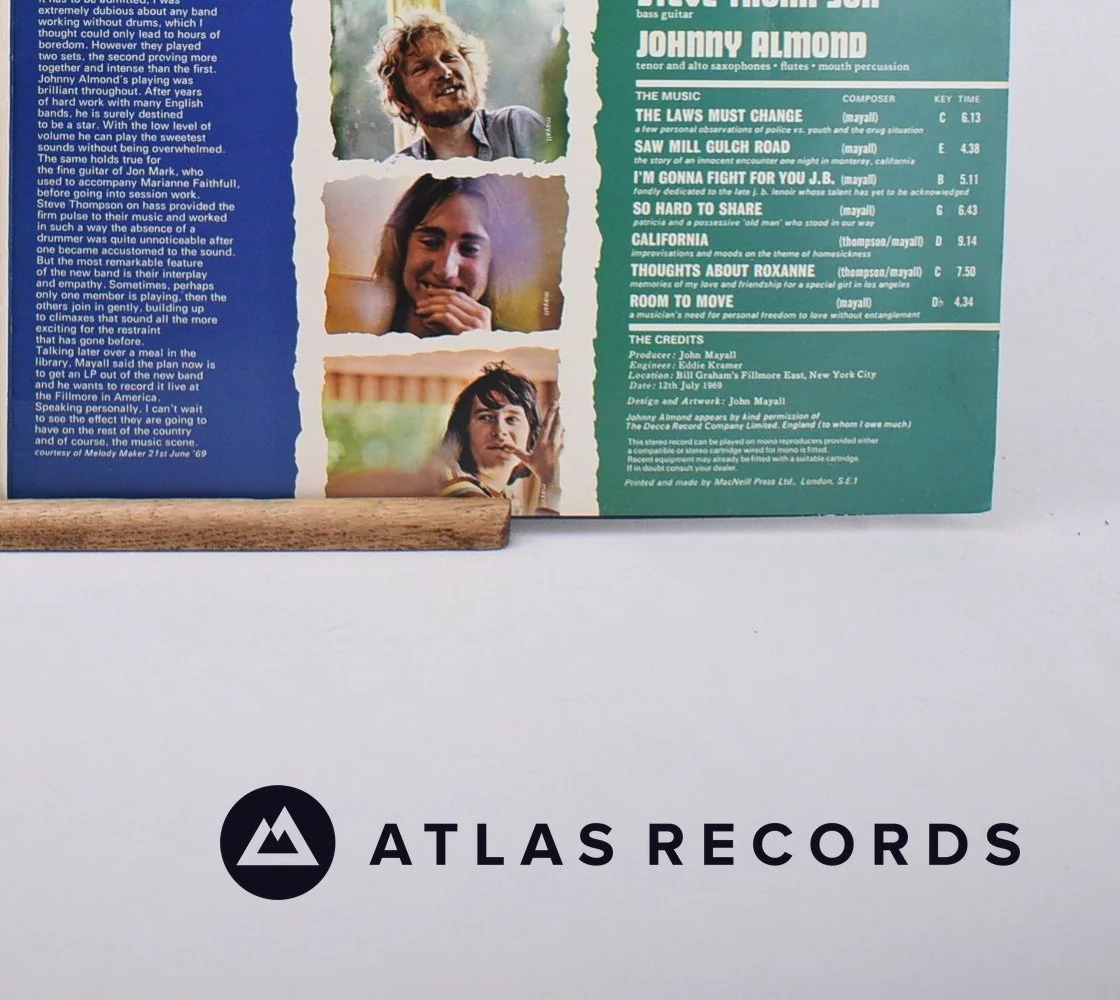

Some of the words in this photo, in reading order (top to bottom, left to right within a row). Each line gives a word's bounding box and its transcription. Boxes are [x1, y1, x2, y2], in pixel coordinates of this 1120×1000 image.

[636, 9, 659, 19] bass
[660, 9, 694, 21] guitar
[636, 30, 742, 58] JOHNNY
[752, 31, 867, 58] ALMOND
[38, 75, 75, 86] Johnny
[78, 75, 128, 84] Almond's
[131, 75, 169, 86] playing
[635, 91, 659, 101] THE
[661, 91, 701, 101] MUSIC
[842, 95, 896, 103] COMPOSER
[635, 108, 661, 122] THE
[665, 108, 703, 122] LAWS
[707, 108, 746, 122] MUST
[749, 109, 803, 123] CHANGE
[842, 112, 878, 124] (mayall)
[939, 112, 946, 122] C
[961, 112, 981, 122] 6.13
[634, 140, 664, 153] SAW
[668, 140, 701, 153] MILL
[705, 140, 749, 153] GULCH
[753, 140, 791, 153] ROAD
[842, 142, 877, 155] (mayall)
[939, 143, 944, 153] E
[960, 143, 980, 153] 4.38
[632, 233, 708, 246] CALIFORNIA
[839, 236, 923, 248] (thompson/mayall)
[936, 236, 942, 246] D
[958, 236, 977, 246] 9.14
[630, 294, 669, 307] ROOM
[673, 294, 691, 308] TO
[695, 294, 734, 308] MOVE
[836, 297, 872, 309] (mayall)
[954, 298, 973, 308] 4.34
[35, 336, 55, 344] that
[58, 336, 76, 344] has
[79, 338, 104, 347] gone
[628, 335, 652, 344] THE
[654, 335, 704, 345] CREDITS
[628, 350, 676, 359] Producer:
[678, 350, 701, 359] John
[704, 350, 736, 361] Mayall
[629, 381, 656, 389] Date:
[658, 381, 678, 389] 12th
[679, 381, 700, 391] July
[702, 381, 723, 389] 1969
[72, 448, 82, 456] of
[84, 448, 116, 459] Melody
[118, 449, 146, 457] Maker
[147, 449, 167, 457] 21st
[169, 449, 190, 457] June
